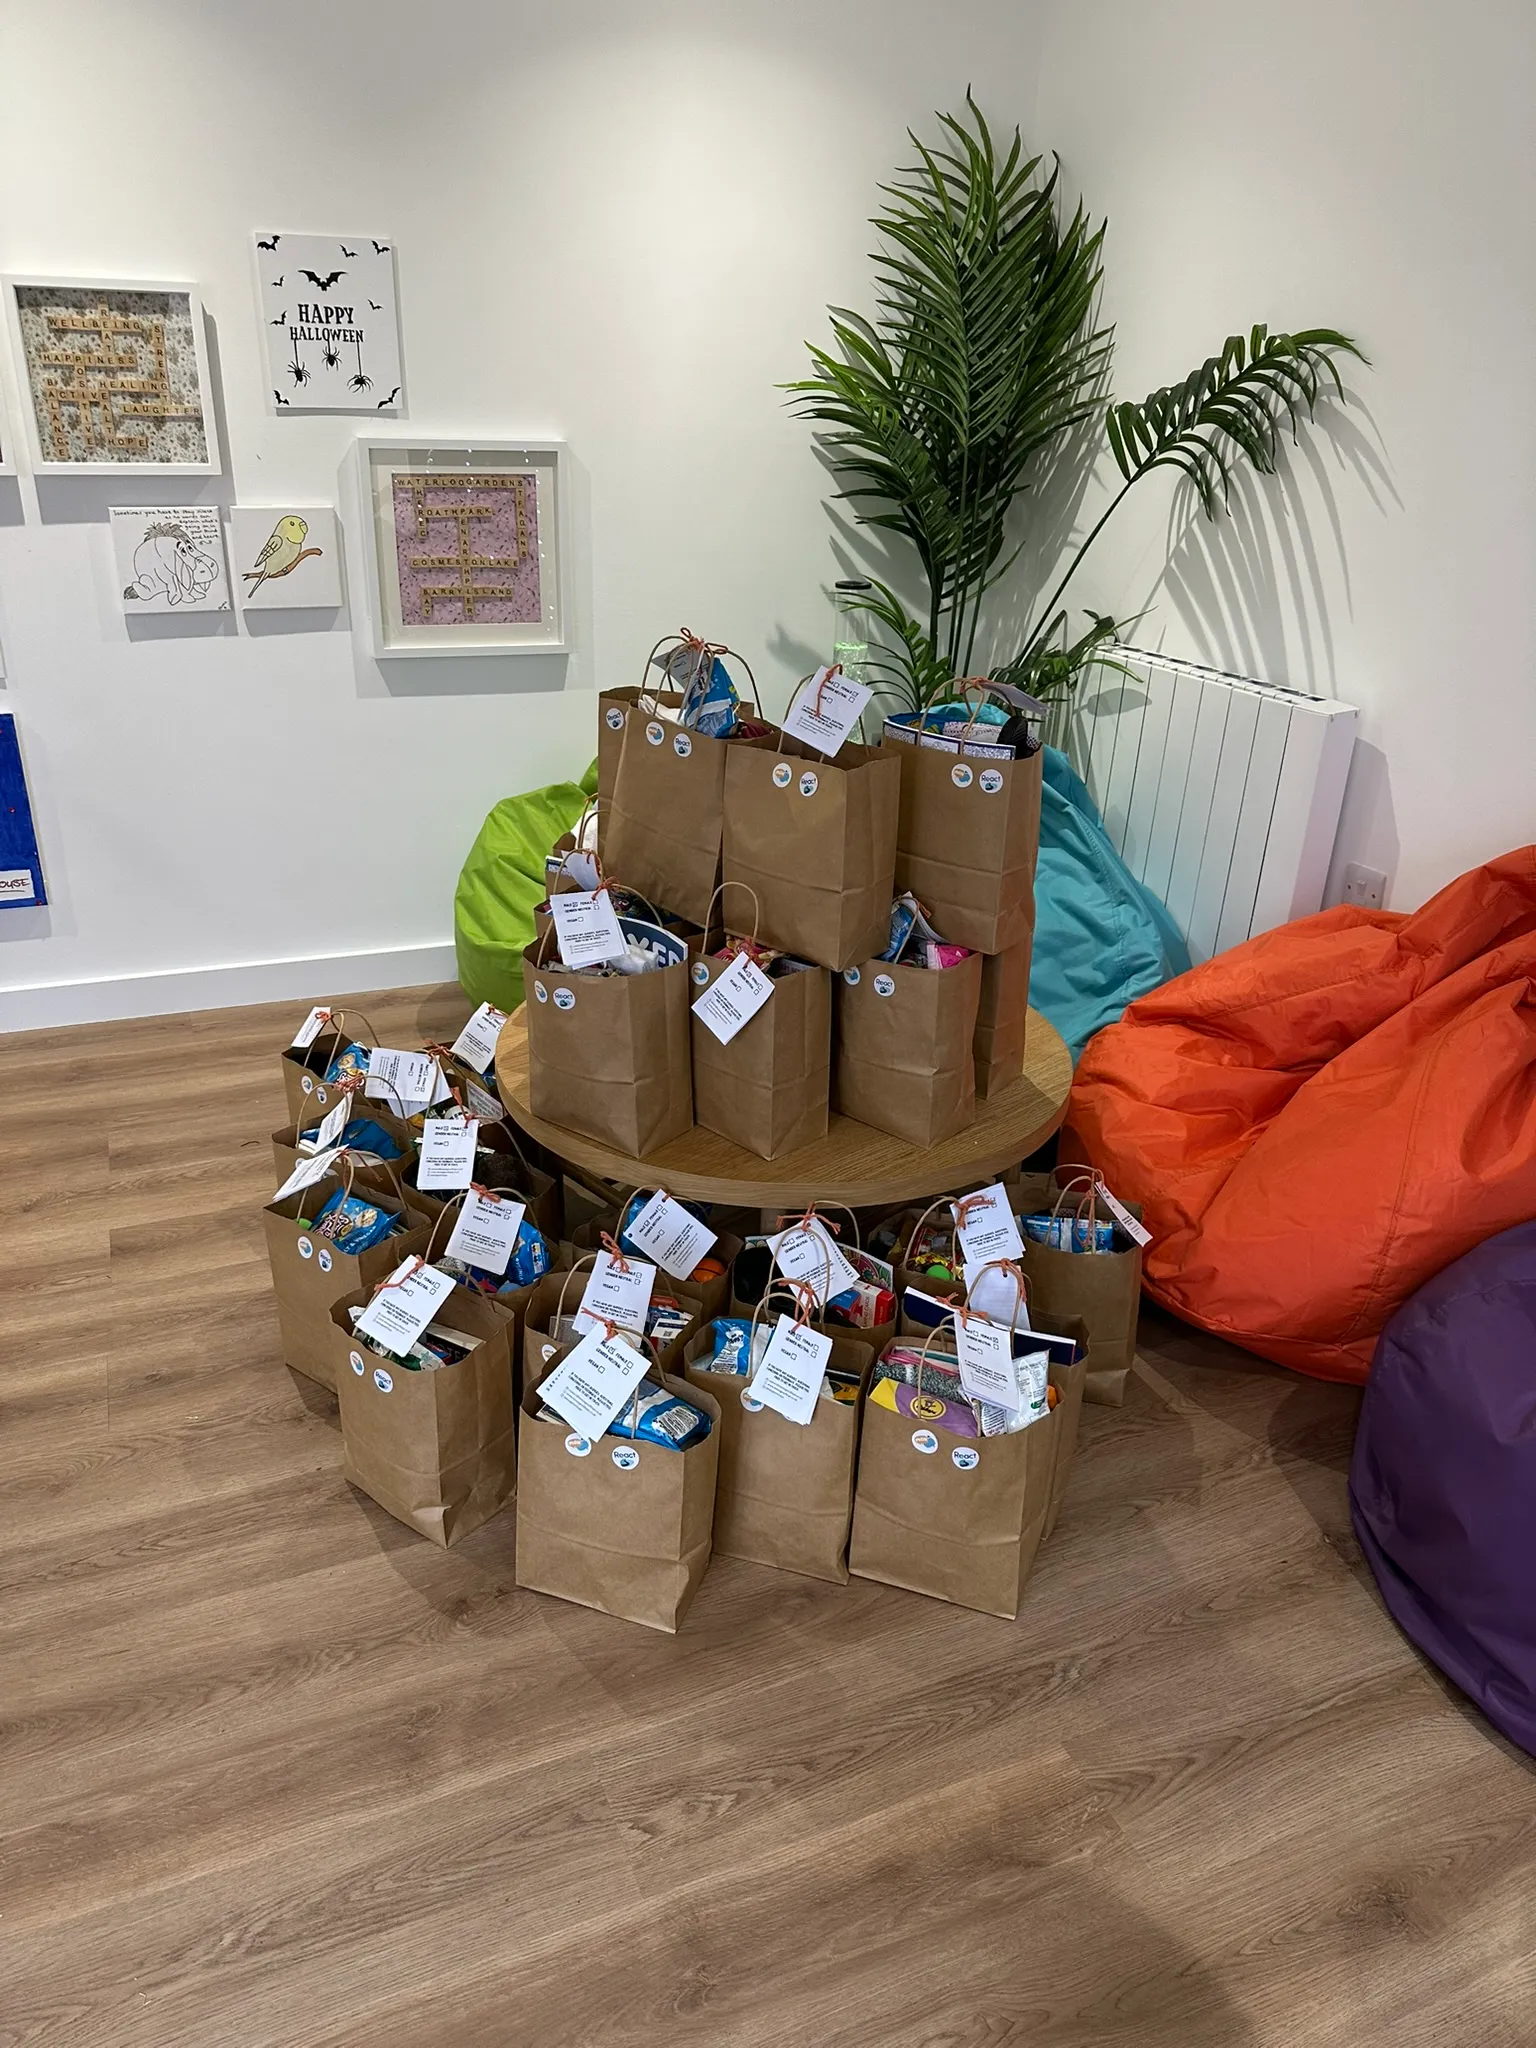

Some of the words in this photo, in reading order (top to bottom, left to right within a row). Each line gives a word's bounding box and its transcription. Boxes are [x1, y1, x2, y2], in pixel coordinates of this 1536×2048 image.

[298, 304, 354, 324] HAPPY
[49, 319, 142, 330] WELLBEING
[289, 326, 364, 343] HALLOWEEN
[43, 354, 135, 365] HAPPINESS
[154, 325, 170, 414] STRENGTH
[100, 380, 169, 391] HEALING
[48, 391, 108, 400] ACTIVE
[75, 355, 94, 446] POSITIVE
[100, 381, 115, 446] HEALTH
[123, 406, 201, 414] LAUGHTER
[47, 379, 66, 457] BALANCE
[107, 438, 146, 447] HOPE
[980, 774, 1001, 783] React
[0, 878, 30, 889] OUSE
[875, 978, 893, 987] React
[554, 992, 573, 1000] React
[613, 1451, 636, 1459] React
[953, 1451, 977, 1460] React
